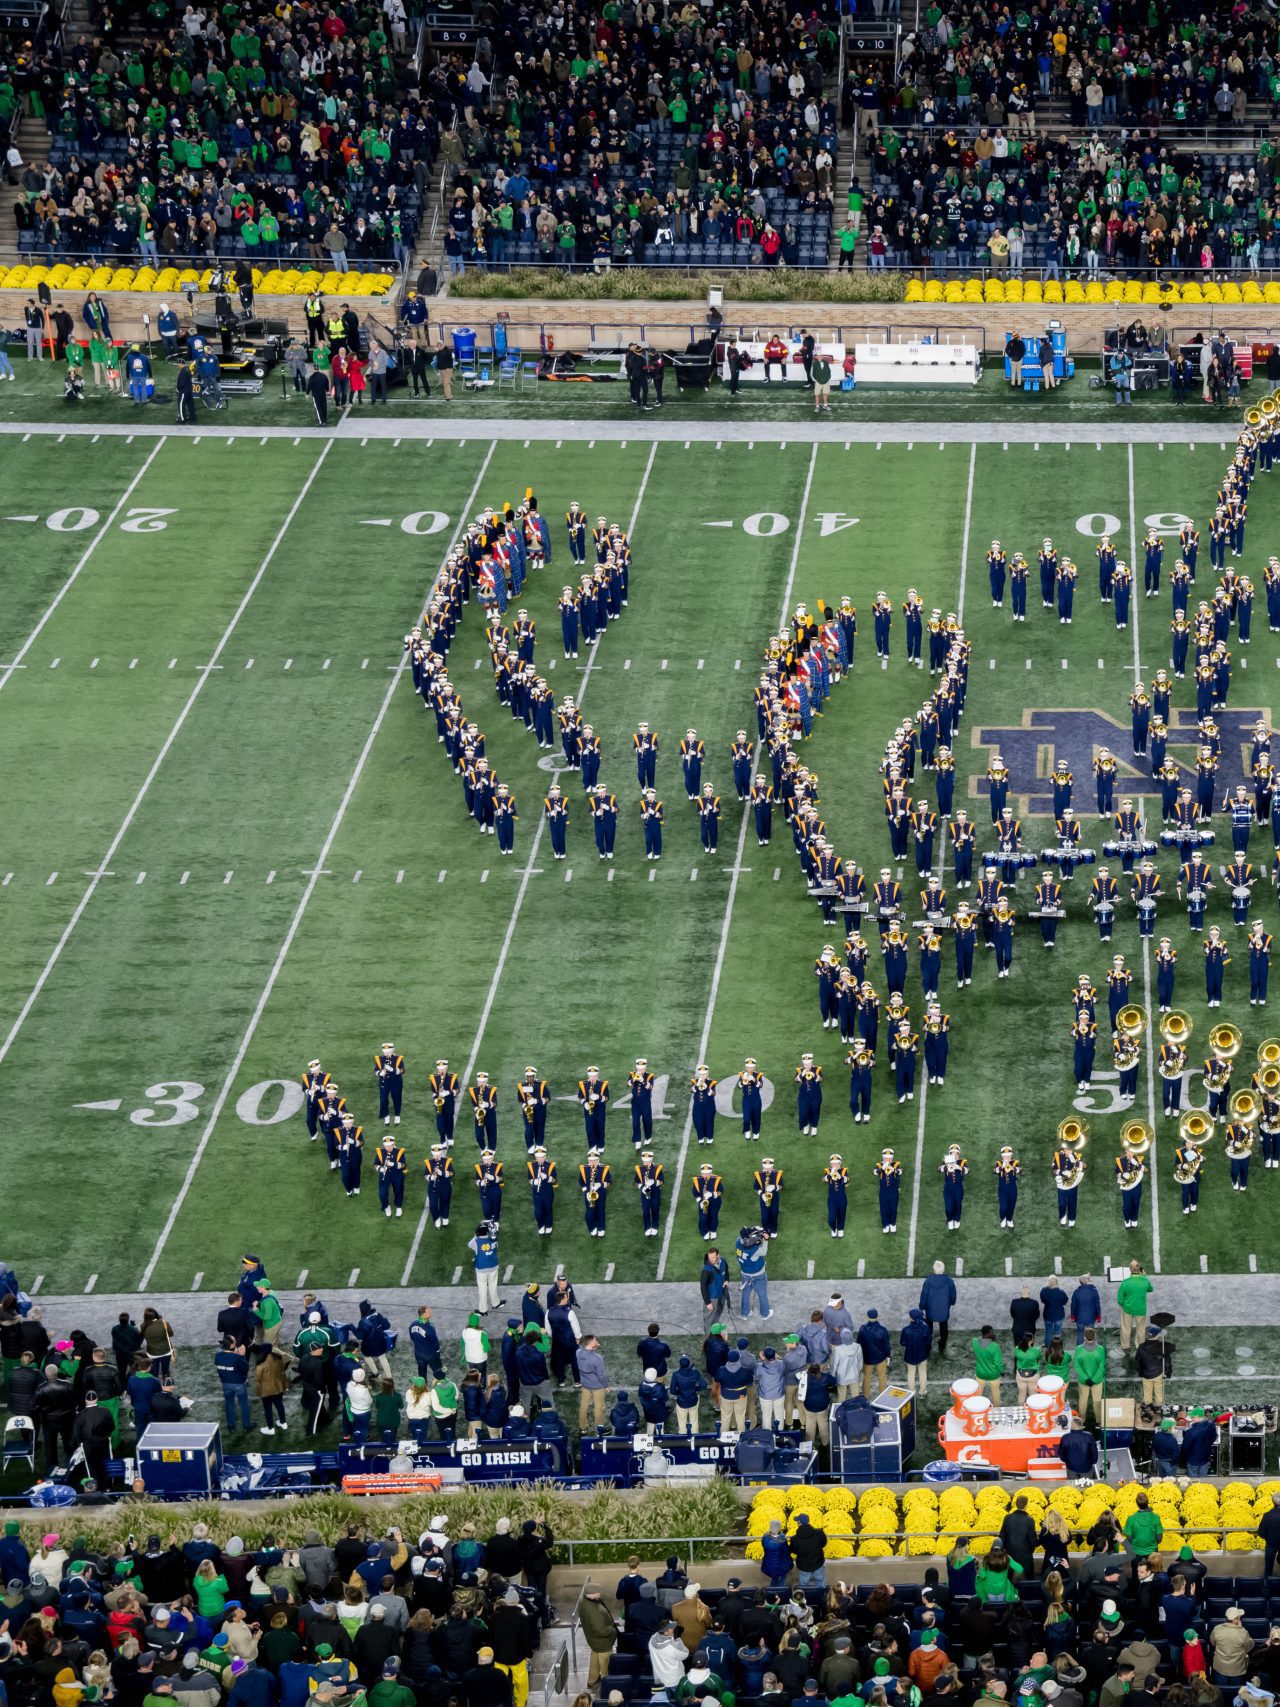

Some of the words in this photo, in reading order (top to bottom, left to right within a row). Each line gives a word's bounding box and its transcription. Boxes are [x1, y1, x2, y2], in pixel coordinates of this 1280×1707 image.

[6, 17, 11, 26] 7
[22, 18, 29, 27] 8
[443, 33, 450, 41] 8
[460, 33, 466, 41] 9
[858, 38, 864, 48] 9
[875, 38, 884, 48] 10
[742, 512, 860, 537] 40
[974, 1416, 984, 1425] G
[1036, 1413, 1046, 1422] G
[700, 1446, 719, 1459] GO
[461, 1453, 482, 1466] GO
[486, 1452, 531, 1465] IRISH
